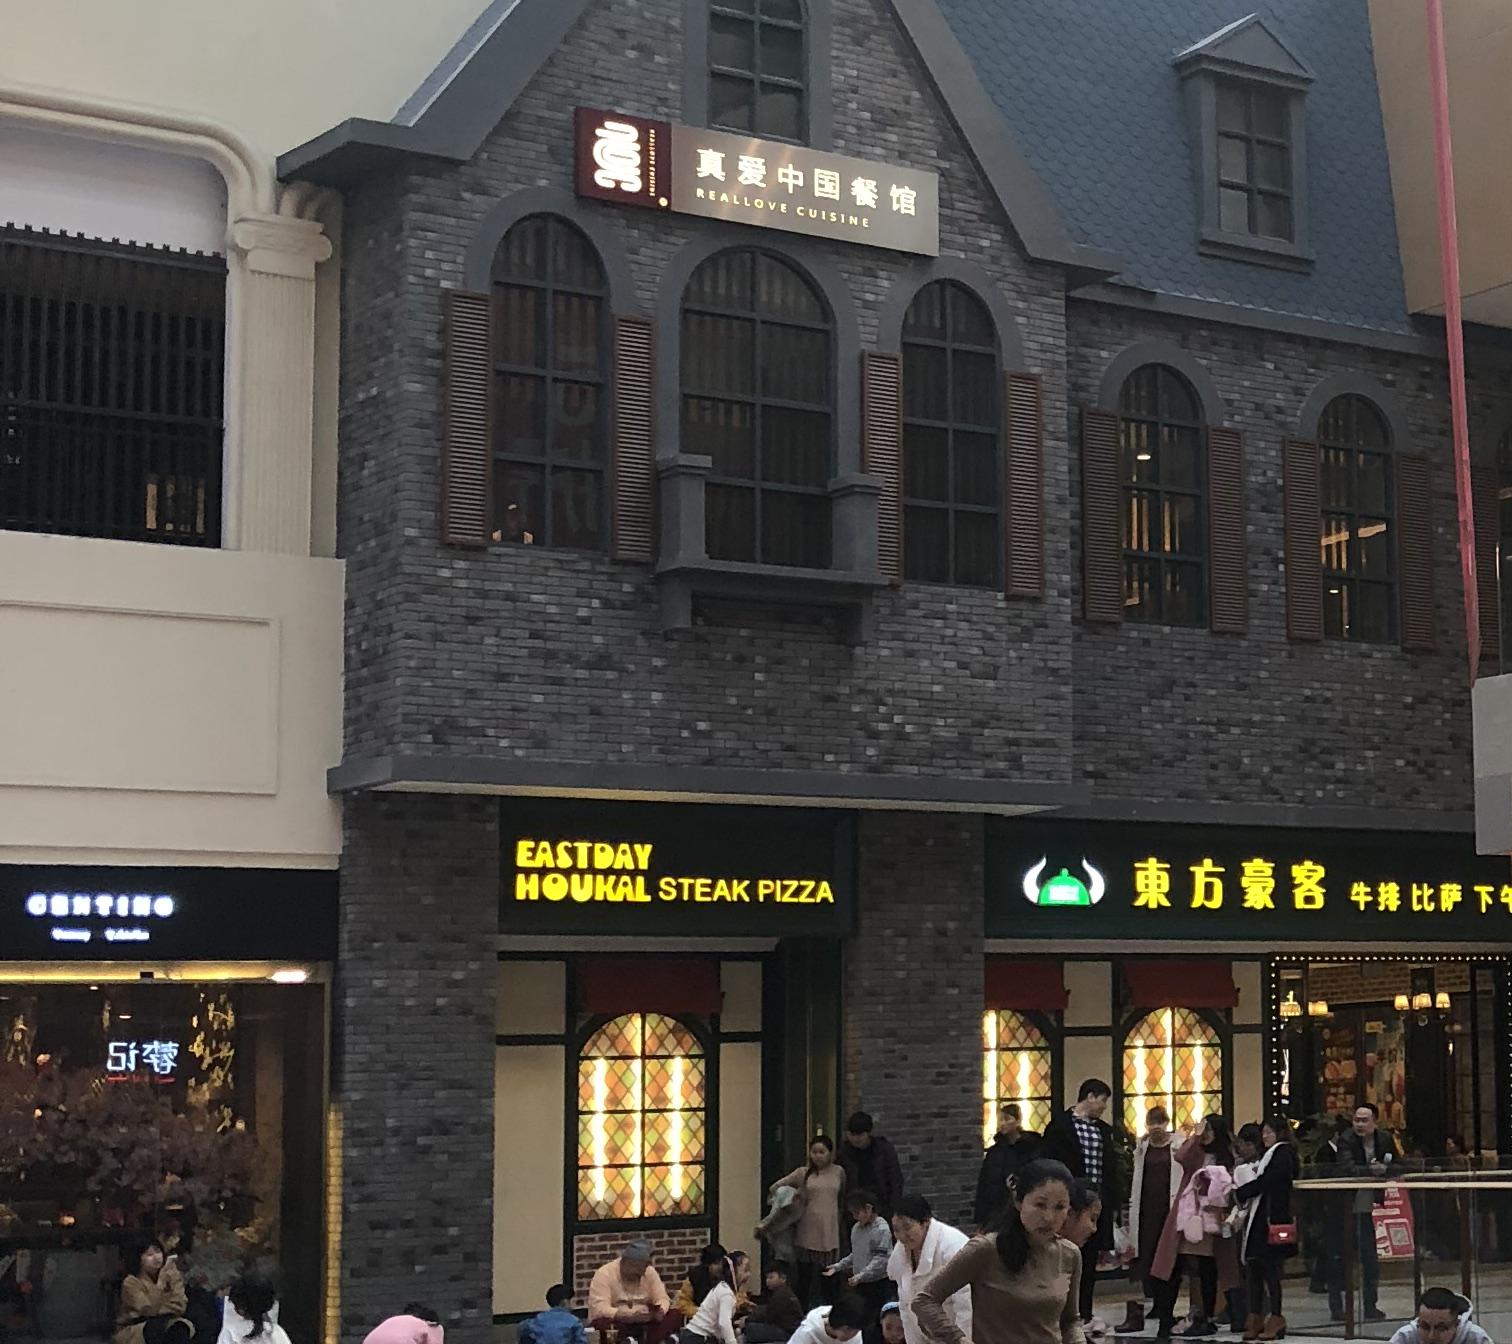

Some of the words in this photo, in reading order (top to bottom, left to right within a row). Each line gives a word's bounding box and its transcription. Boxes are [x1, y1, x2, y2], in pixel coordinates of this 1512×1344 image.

[696, 148, 917, 216] 真爱中国餐馆
[696, 188, 787, 213] REALLOVE
[796, 206, 869, 228] CUISINE
[516, 841, 652, 870] EASTDAY
[515, 873, 651, 902] HOUKAL
[658, 877, 750, 903] STEAK
[757, 879, 834, 903] PIZZA
[1133, 857, 1327, 909] 東方豪客
[1350, 881, 1401, 912] 牛排
[1411, 882, 1463, 912] 比萨
